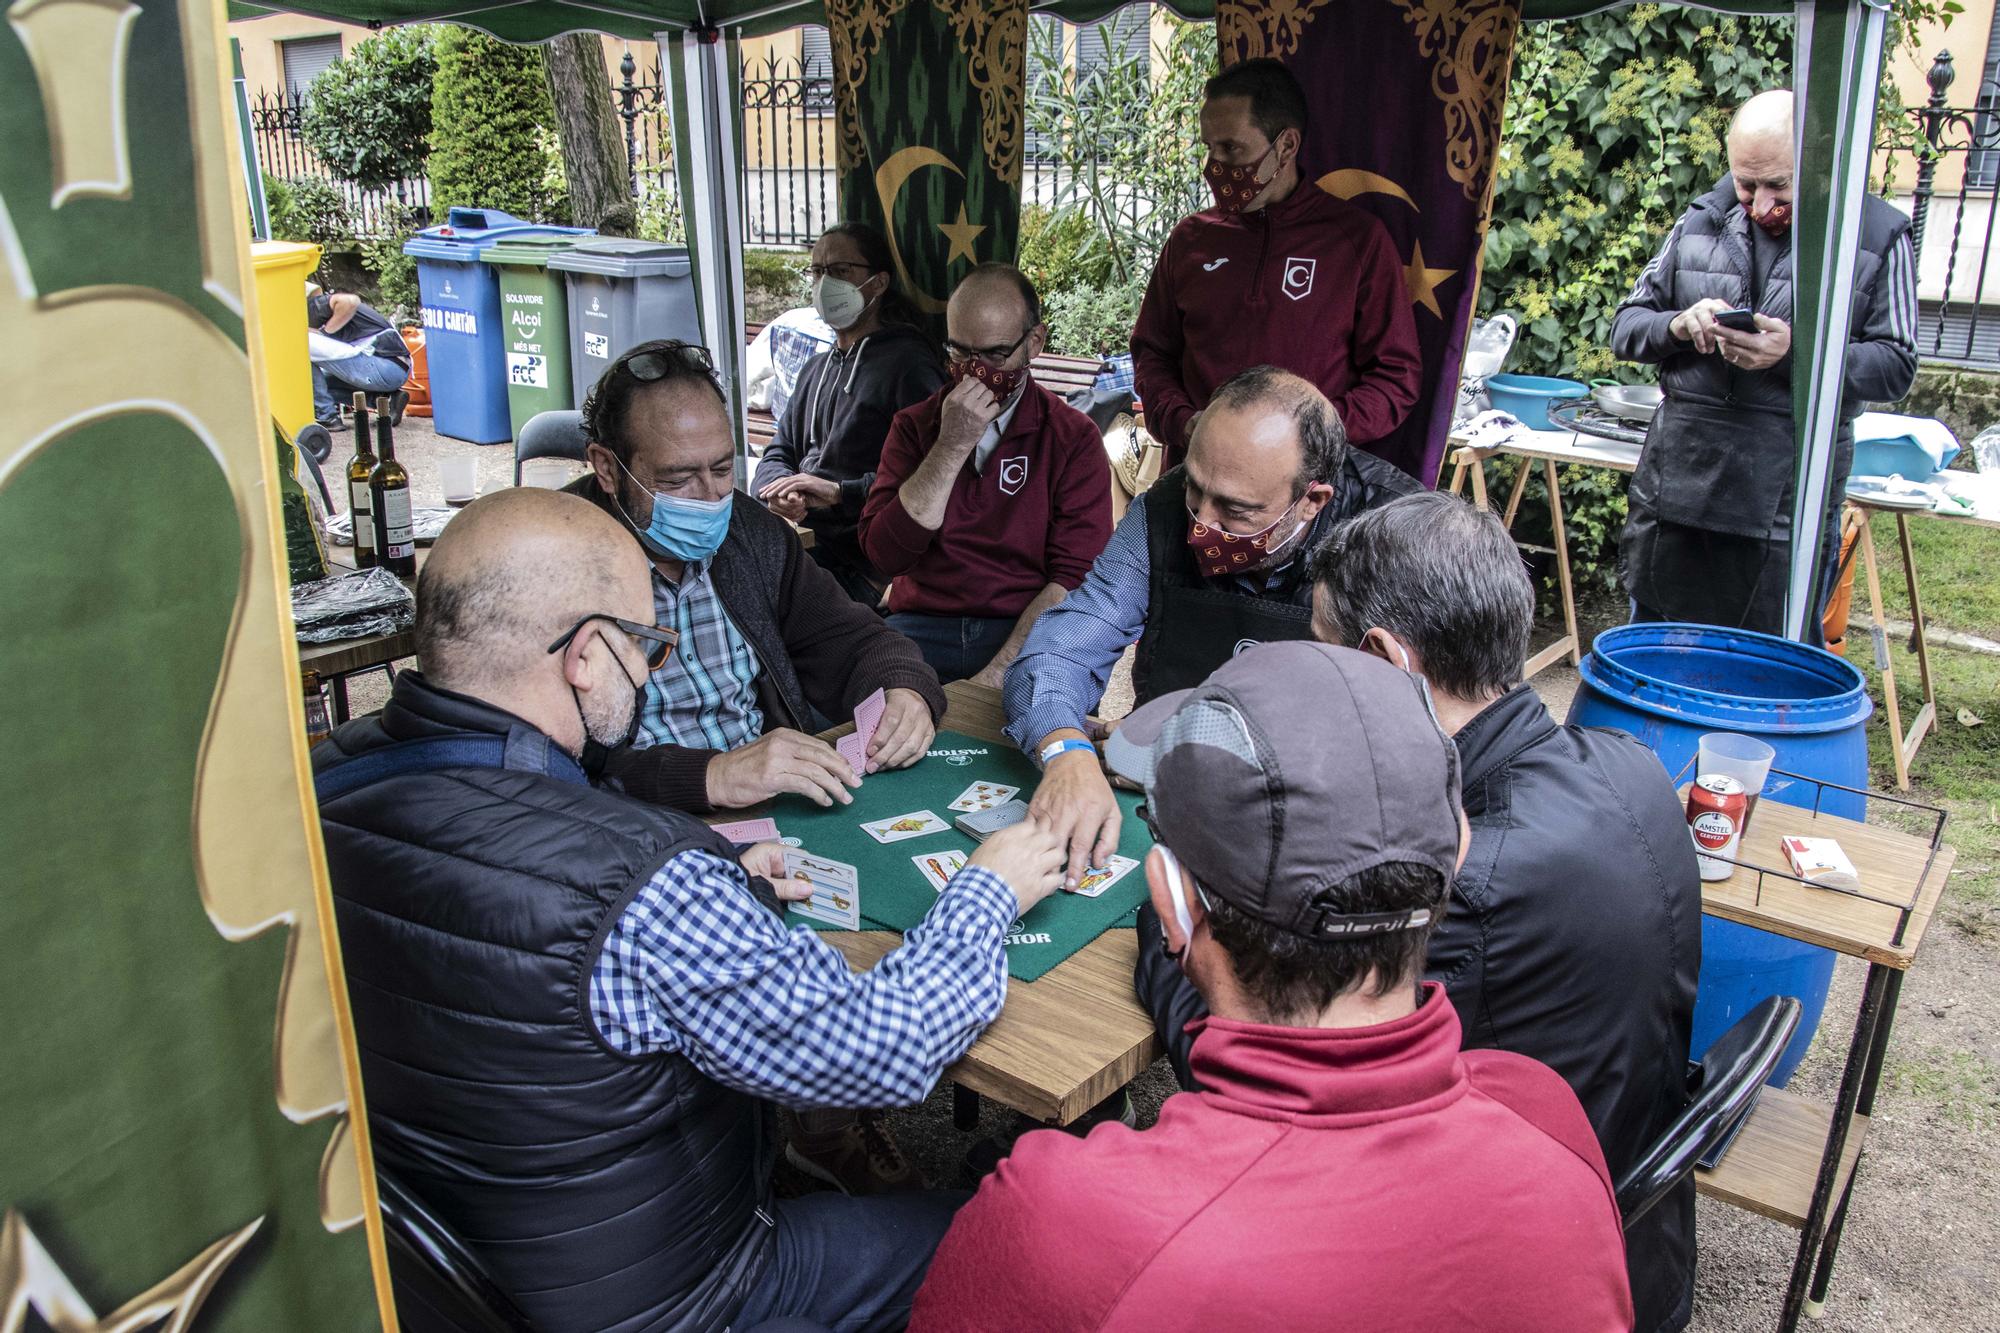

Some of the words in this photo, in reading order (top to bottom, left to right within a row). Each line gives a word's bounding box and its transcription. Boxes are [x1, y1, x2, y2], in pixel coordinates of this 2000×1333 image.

[505, 293, 523, 304] SOLS
[523, 294, 544, 305] VIDRE
[422, 307, 444, 329] SOLO
[511, 310, 542, 327] Alcoi
[528, 344, 542, 353] NET
[512, 365, 536, 384] FCC
[926, 748, 989, 757] PASTOR
[1699, 823, 1729, 834] AMSTEL
[1699, 832, 1725, 841] CERVEZA
[1002, 932, 1052, 946] STOR
